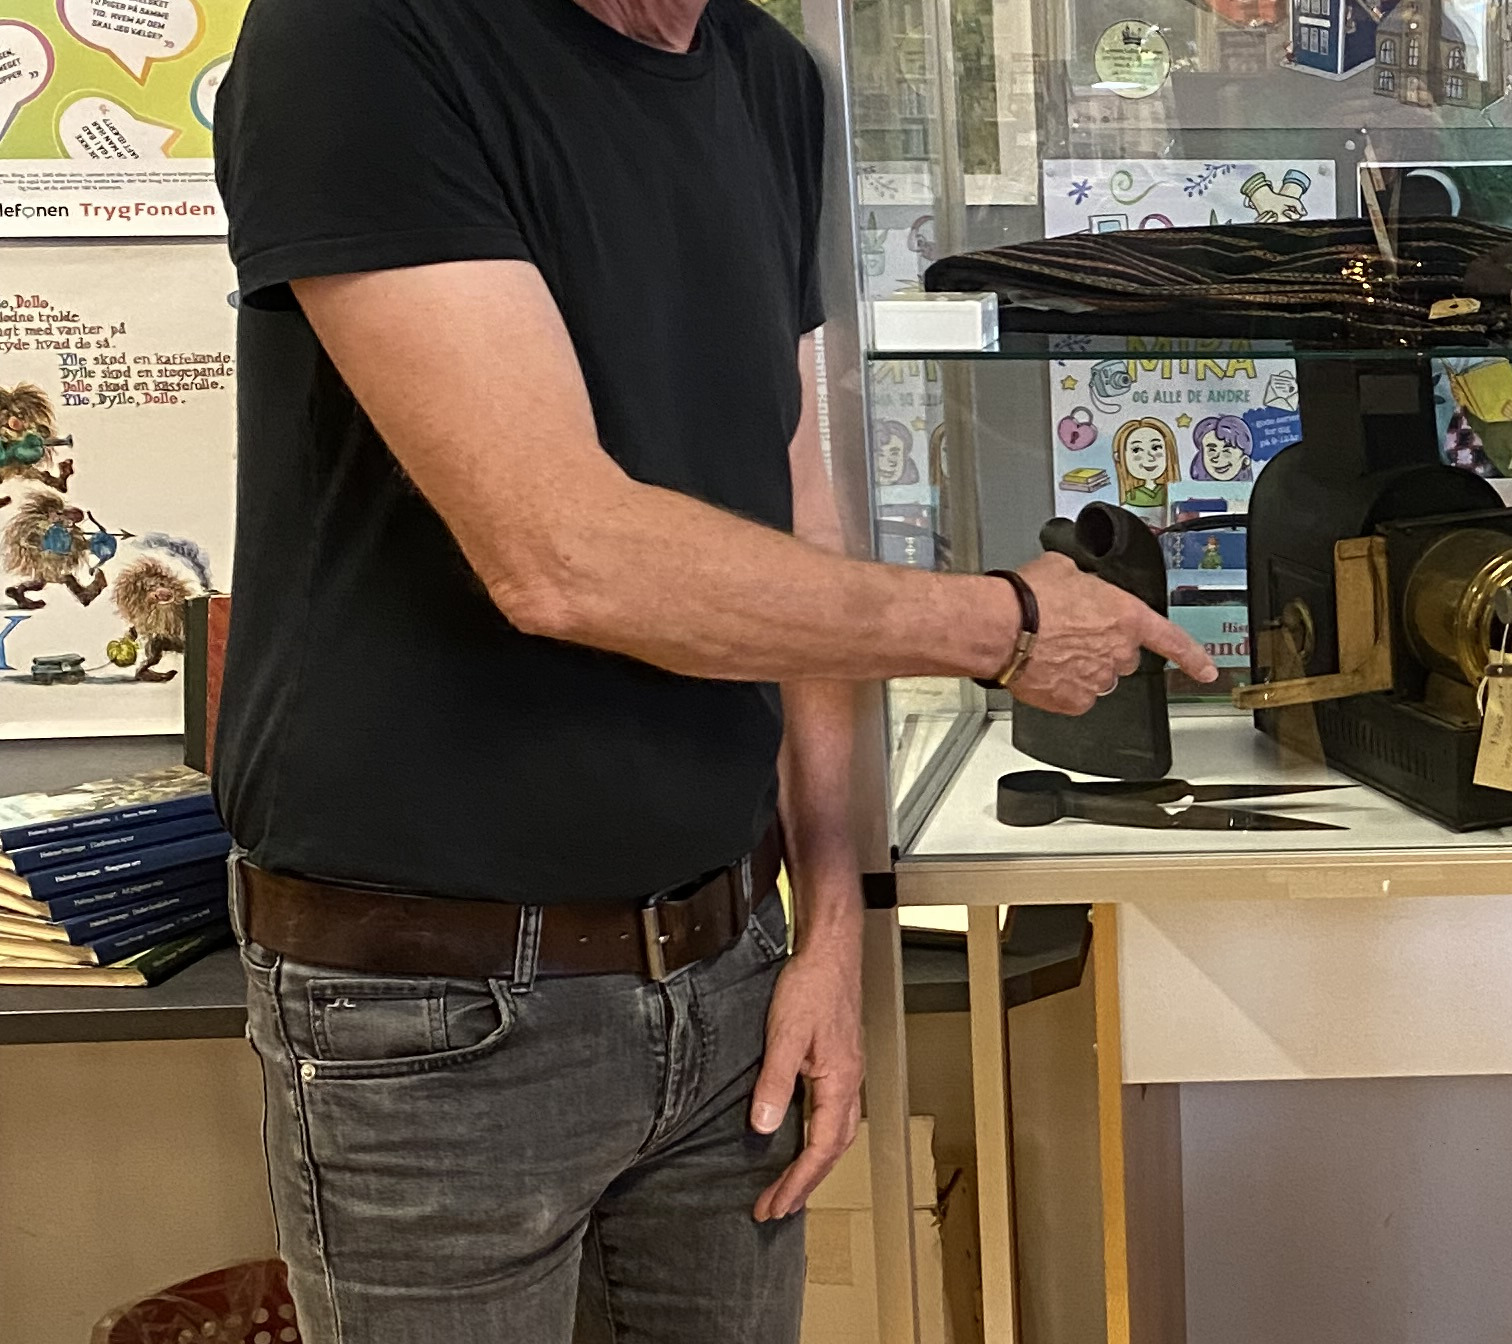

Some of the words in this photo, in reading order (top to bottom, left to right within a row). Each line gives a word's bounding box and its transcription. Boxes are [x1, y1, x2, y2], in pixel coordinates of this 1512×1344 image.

[102, 0, 126, 10] PIGER
[127, 4, 138, 13] PÅ
[139, 7, 169, 20] SAMME
[92, 20, 112, 30] SKAL
[114, 25, 129, 33] JEG
[111, 13, 134, 23] HVEM
[147, 20, 165, 29] DEM
[14, 295, 54, 312] Dolle,
[38, 311, 80, 323] trolde
[25, 323, 54, 336] med
[56, 323, 103, 336] vanter
[110, 322, 127, 338] på
[35, 338, 71, 350] hvad
[74, 337, 92, 349] de
[95, 337, 116, 349] så.
[58, 353, 87, 366] Ylle
[133, 357, 150, 365] en
[59, 366, 96, 381] Dylle
[137, 370, 153, 378] en
[62, 381, 93, 393] Dolle
[133, 382, 149, 391] en
[96, 392, 140, 409] Dylle,
[1132, 390, 1149, 403] OG
[1153, 389, 1182, 403] ALLE
[1187, 389, 1201, 403] DE
[1206, 389, 1251, 403] ANDRE
